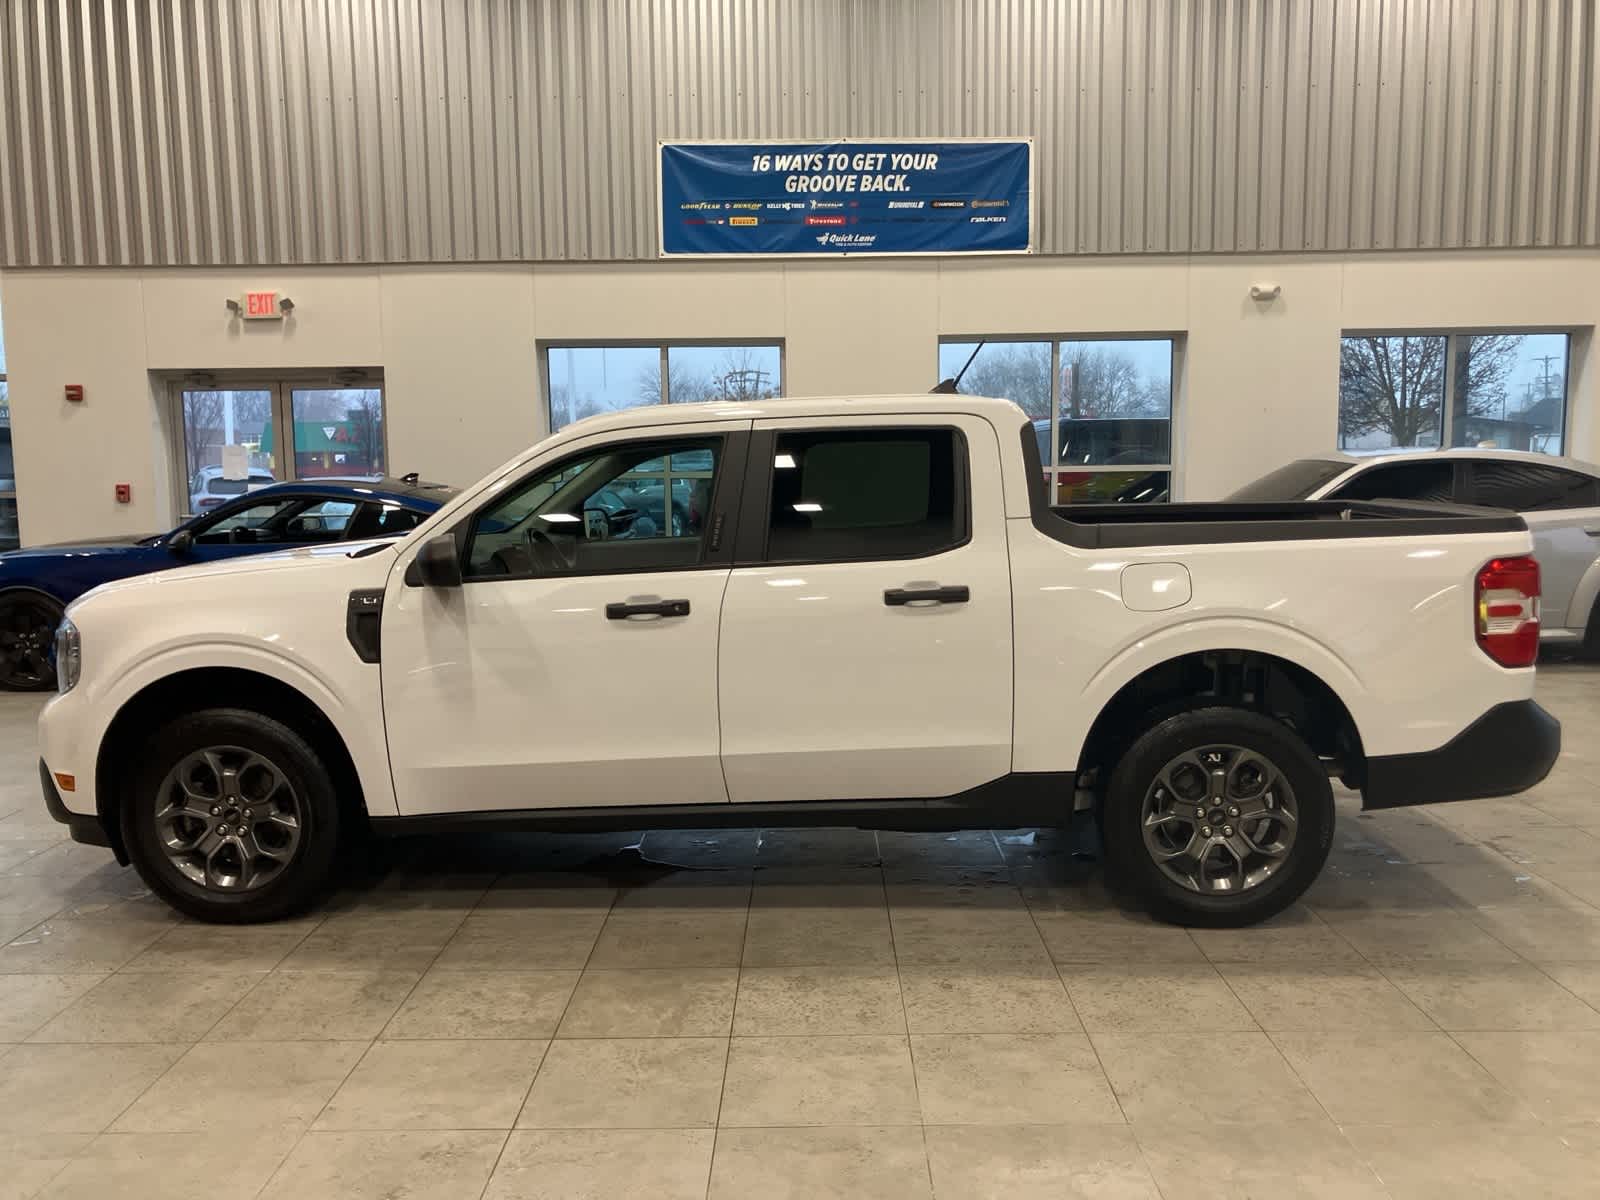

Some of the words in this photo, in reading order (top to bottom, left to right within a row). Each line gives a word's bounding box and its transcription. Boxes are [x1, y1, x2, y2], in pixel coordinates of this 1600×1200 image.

[752, 155, 771, 172] 16
[774, 154, 824, 172] WAYS
[827, 153, 849, 171] TO
[852, 153, 887, 171] GET
[891, 153, 939, 171] YOUR
[785, 175, 857, 193] GROOVE
[860, 174, 912, 192] BACK.
[829, 234, 854, 243] Quick
[853, 234, 877, 242] Lane
[247, 293, 275, 316] EXIT
